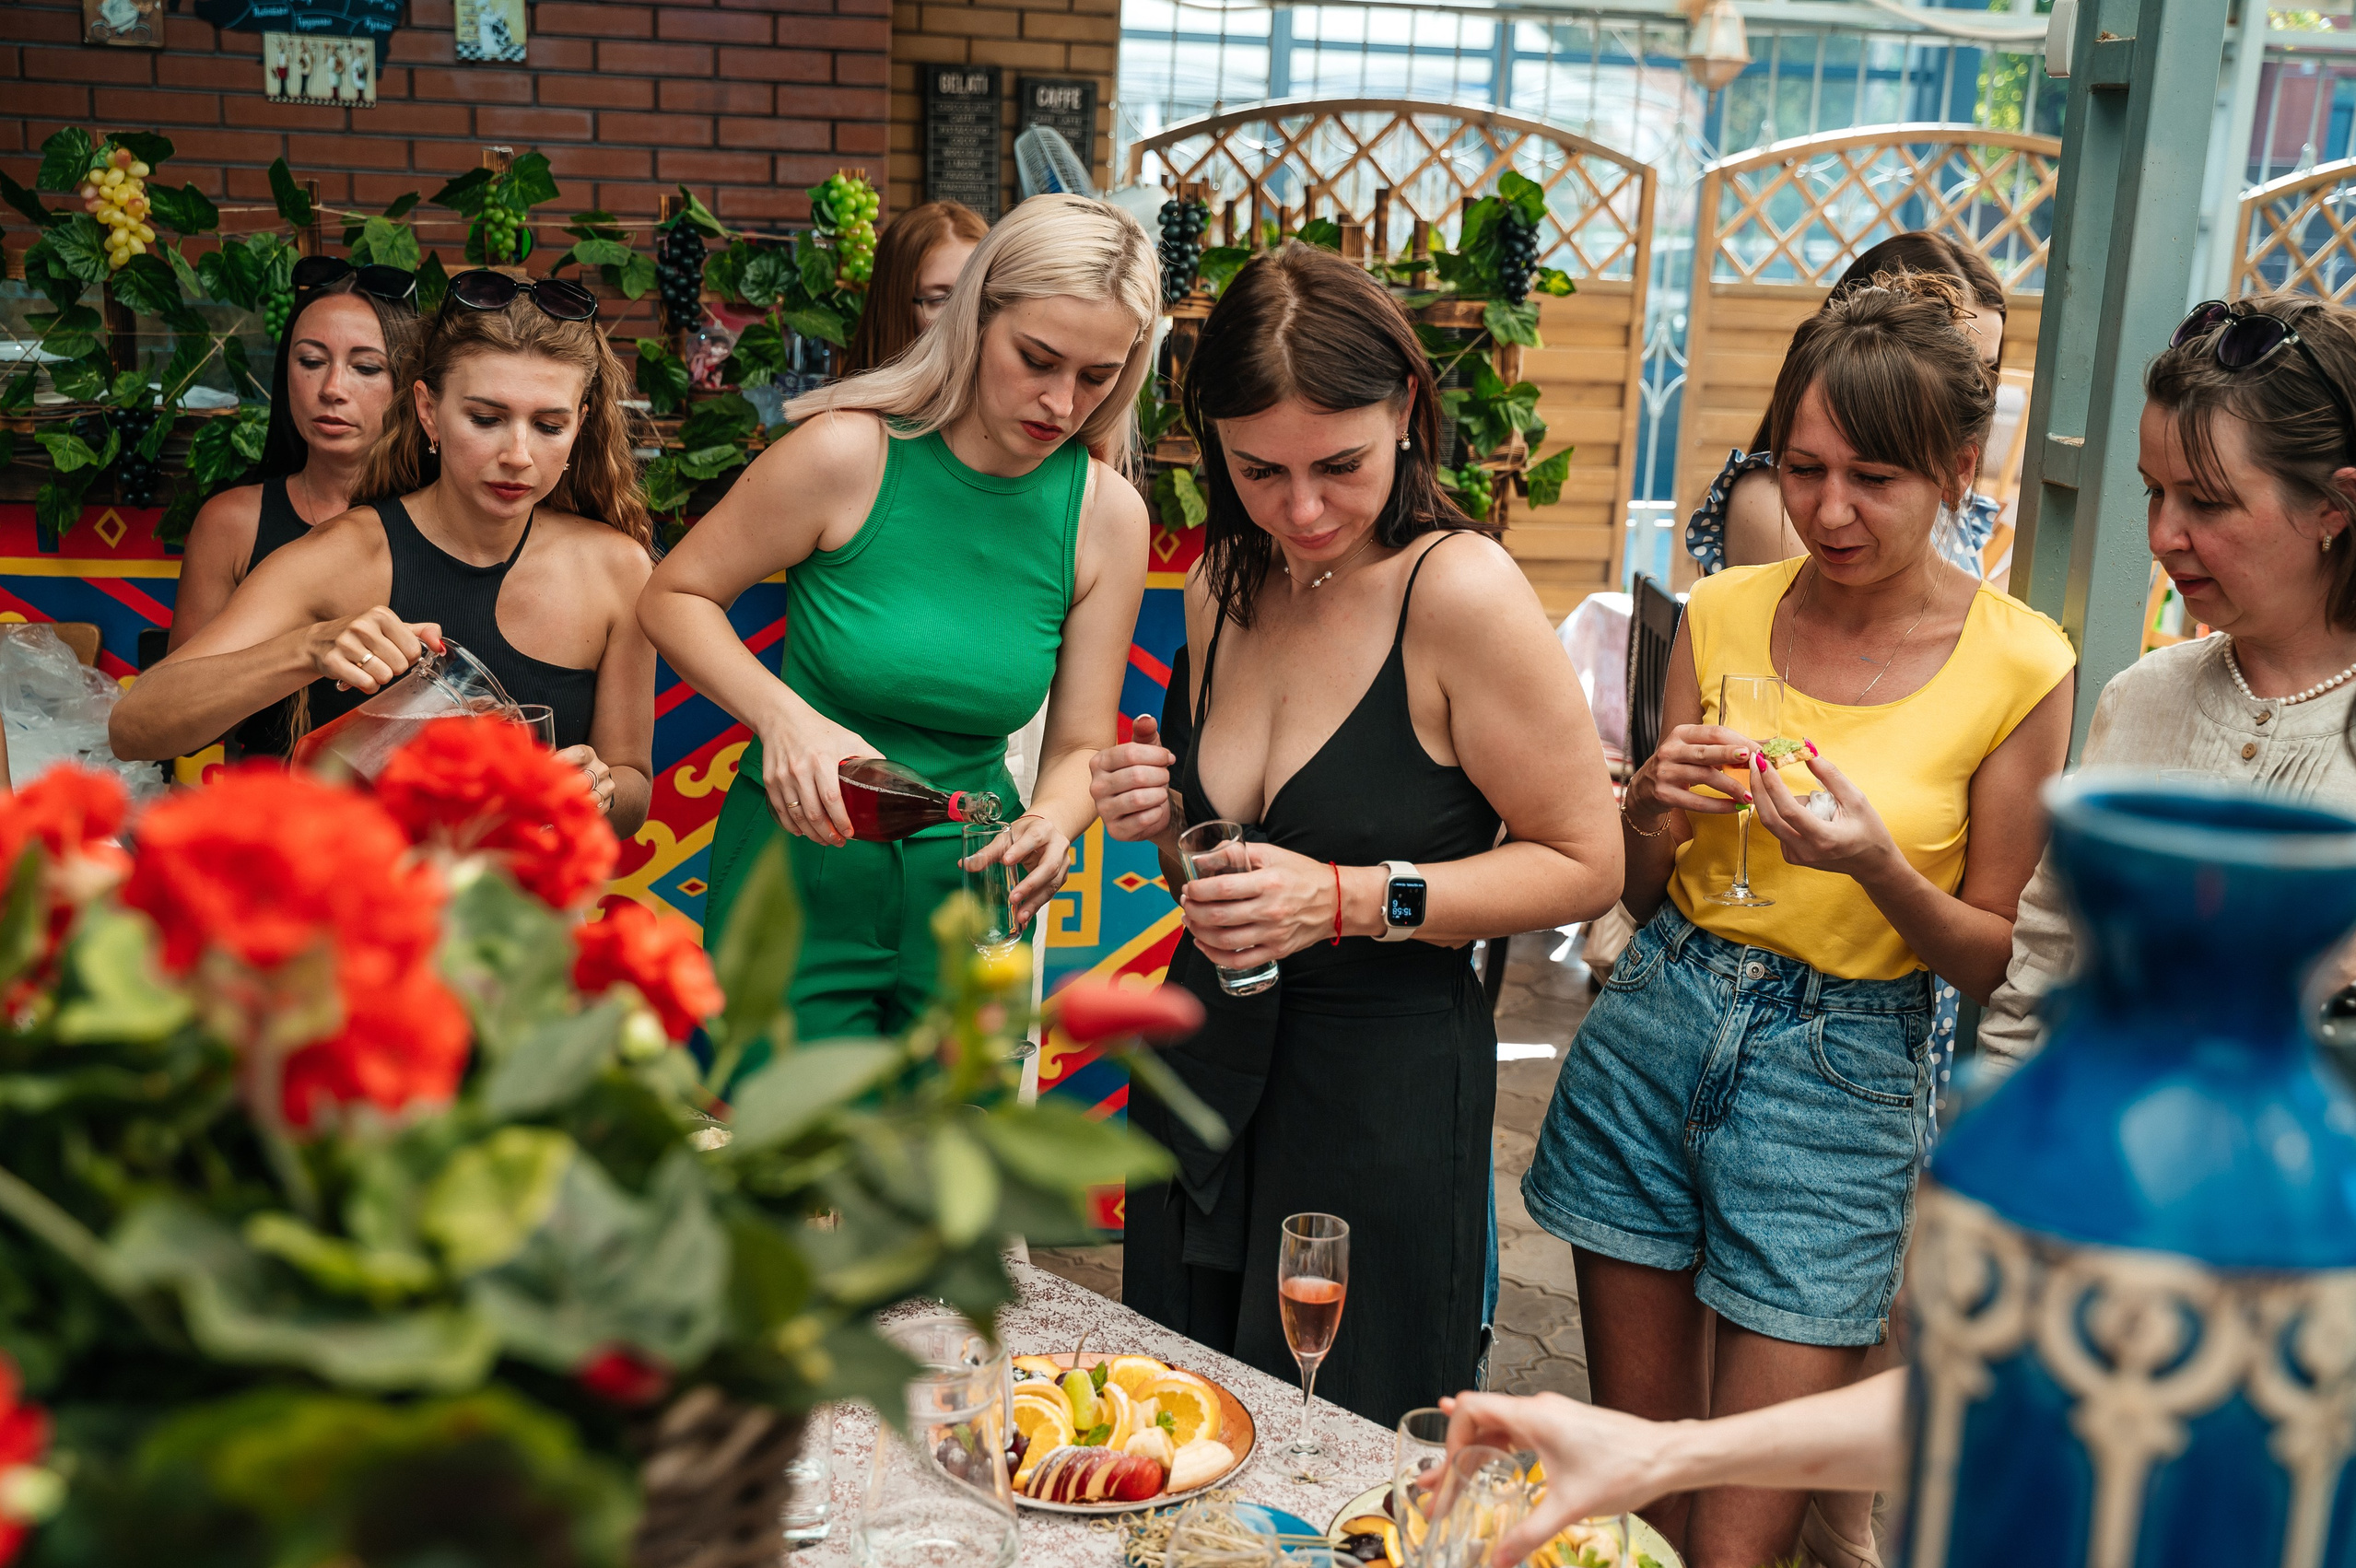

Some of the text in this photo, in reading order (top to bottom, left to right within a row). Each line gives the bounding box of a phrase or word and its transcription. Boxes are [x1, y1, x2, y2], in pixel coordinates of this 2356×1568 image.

[939, 73, 988, 94] GELATI
[1037, 87, 1083, 109] CAFFE
[1392, 907, 1412, 916] 15:58
